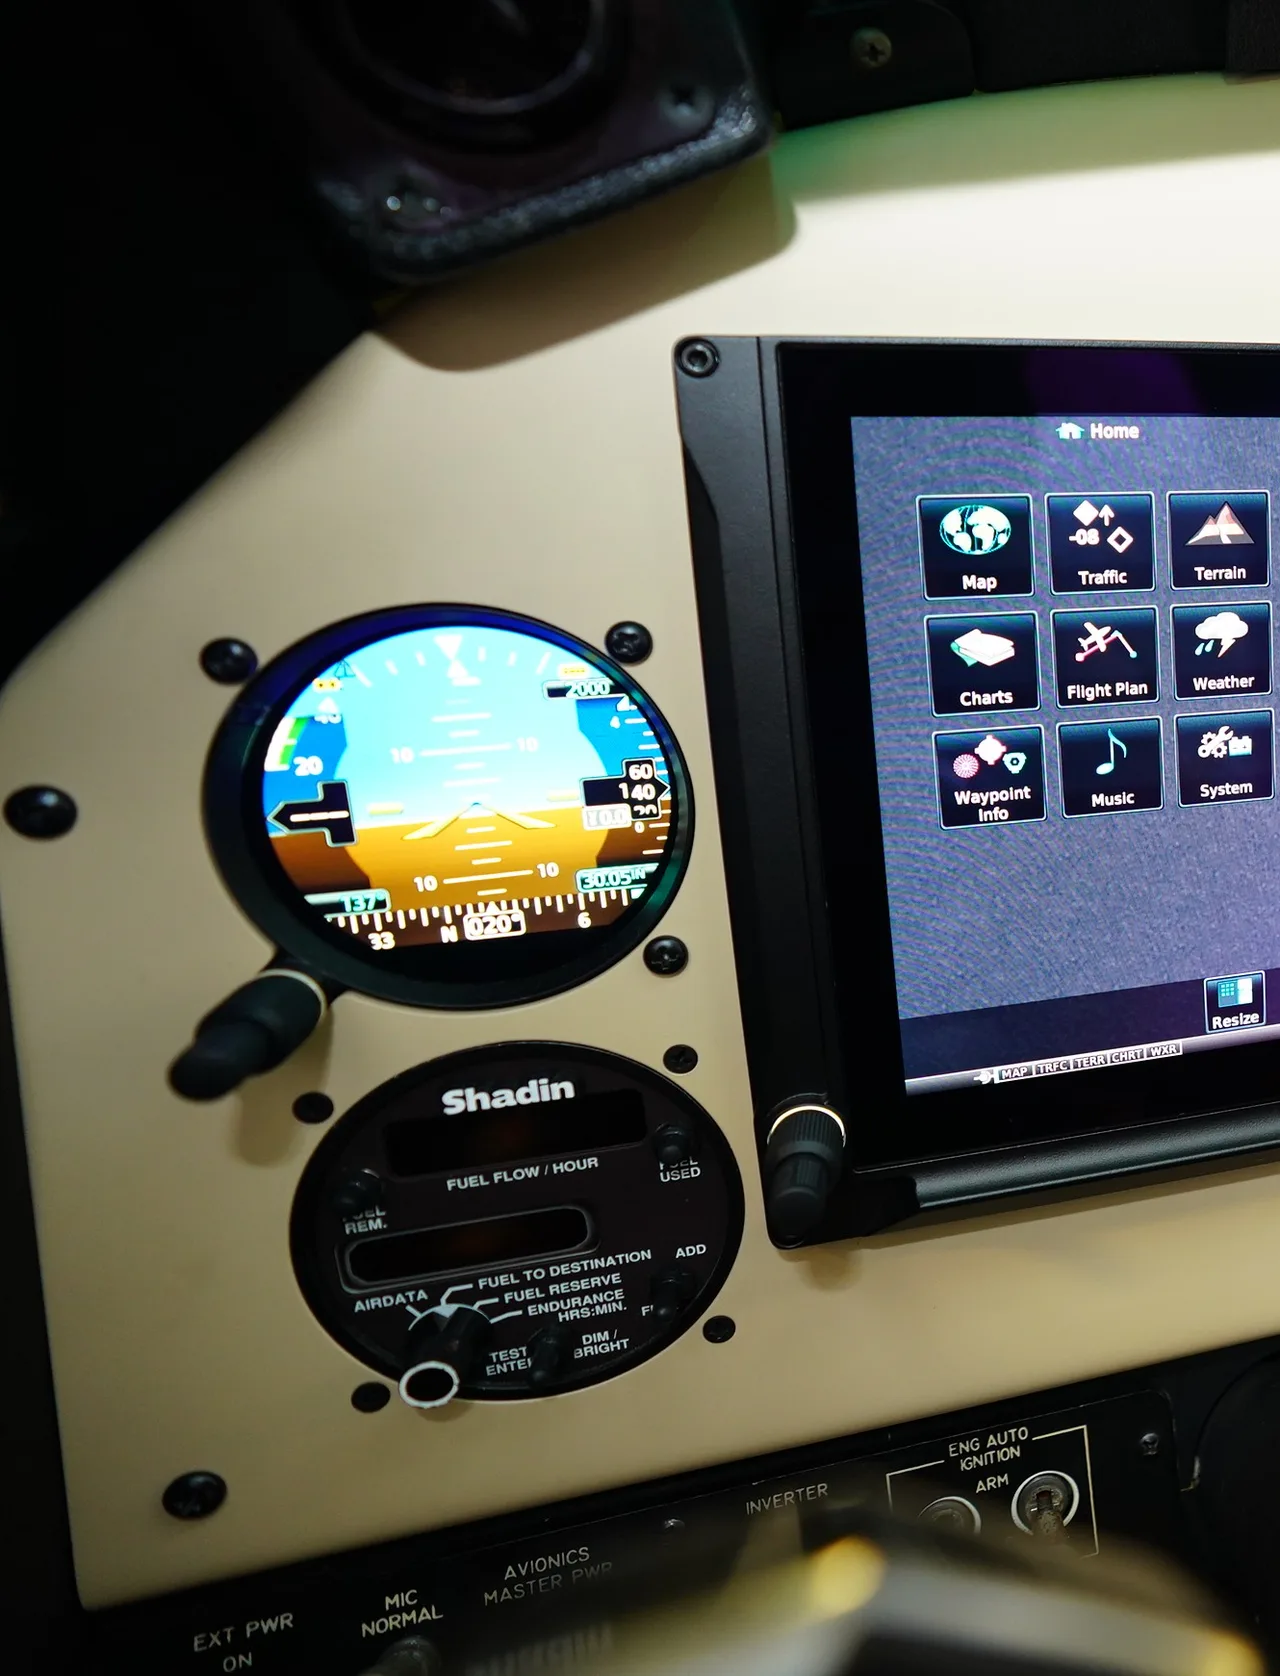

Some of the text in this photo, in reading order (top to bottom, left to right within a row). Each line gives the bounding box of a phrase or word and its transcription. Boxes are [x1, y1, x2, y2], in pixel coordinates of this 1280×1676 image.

[1090, 423, 1140, 440] Home
[1069, 528, 1100, 546] -08
[962, 575, 997, 592] Map
[1078, 569, 1128, 586] Traffic
[1194, 565, 1247, 582] Terrain
[565, 680, 610, 699] 2000
[1067, 681, 1148, 701] Flight Plan
[1193, 674, 1255, 692] Weather
[959, 690, 1013, 707] Charts
[293, 755, 323, 777] 20
[628, 763, 653, 780] 60
[954, 786, 1031, 807] Waypoint
[1091, 791, 1135, 808] Music
[1199, 781, 1253, 799] System
[978, 806, 1009, 822] Info
[537, 862, 559, 879] 10
[413, 875, 438, 892] 10
[368, 911, 592, 950] 33 N 020° 6
[1211, 1011, 1260, 1030] Resize
[1001, 1043, 1177, 1080] MAP TRFC TERR CHRT WXR
[441, 1078, 575, 1116] Shadin
[446, 1156, 599, 1191] FUEL FLOW HOUR
[659, 1166, 701, 1183] USED
[344, 1217, 388, 1235] REM.
[675, 1244, 707, 1260] ADD
[478, 1249, 652, 1290] FUEL TO DESTINATION
[503, 1272, 622, 1304] FUEL RESERVE
[354, 1289, 428, 1313] AIRDATA
[527, 1289, 625, 1317] ENDURANCE
[557, 1303, 628, 1323] HRS:MIN.
[573, 1338, 630, 1359] BRIGHT
[581, 1331, 610, 1346] DIM
[489, 1346, 527, 1363] TEST
[948, 1427, 1029, 1458] ENG AUTO
[959, 1445, 1021, 1471] IGNITION
[975, 1473, 1010, 1495] ARM
[745, 1483, 829, 1516] INVERTER
[503, 1546, 591, 1581] AVIONICS
[484, 1562, 613, 1607] MASTER PWR
[384, 1589, 419, 1611] MIC
[361, 1605, 444, 1638] NORMAL
[193, 1613, 294, 1653] EXT PWR
[222, 1652, 253, 1673] ON
